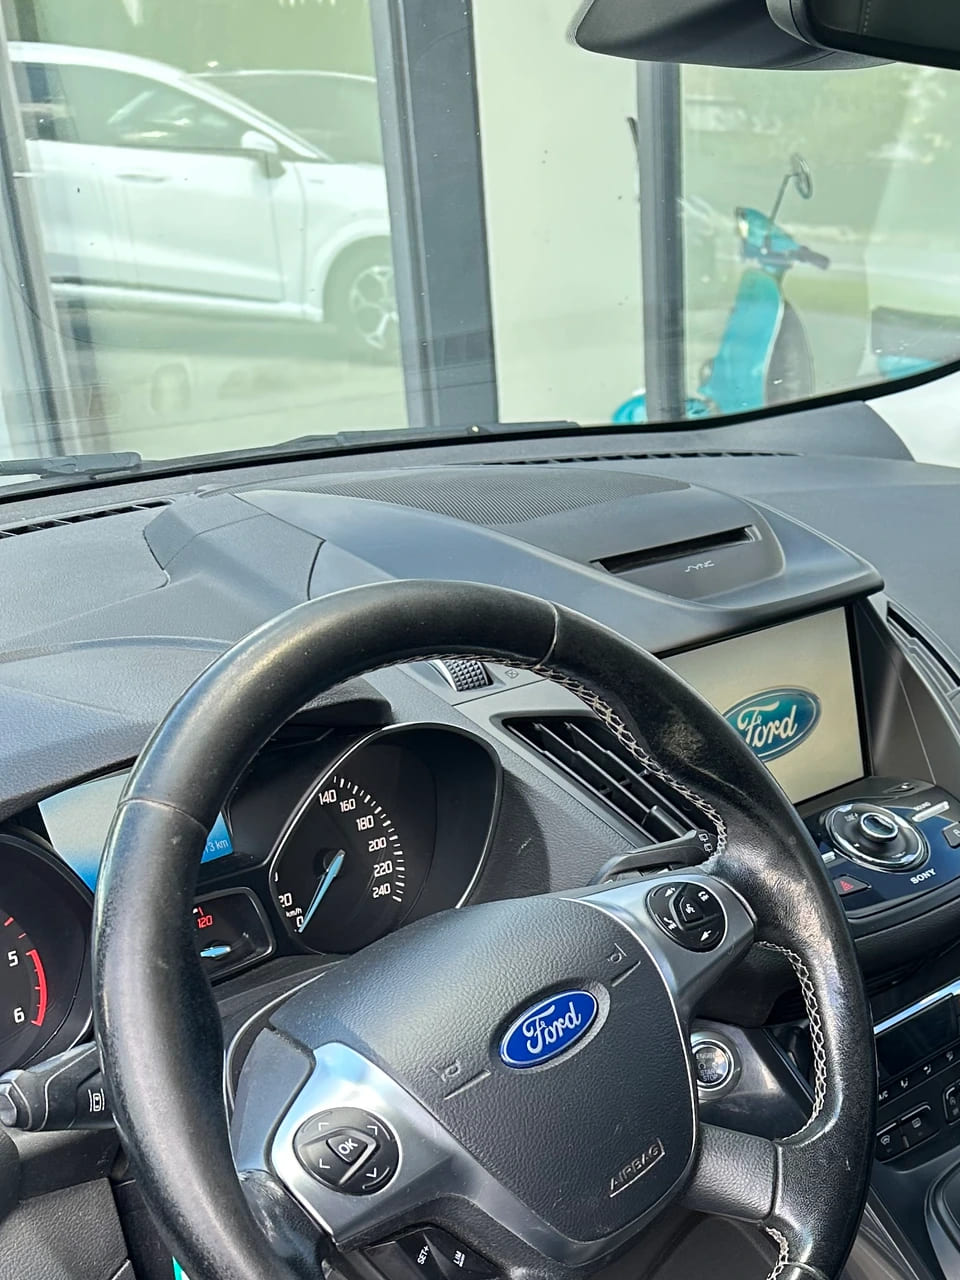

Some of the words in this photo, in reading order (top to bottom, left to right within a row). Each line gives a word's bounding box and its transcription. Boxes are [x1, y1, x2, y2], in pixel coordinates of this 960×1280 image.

[737, 700, 798, 748] Ford
[318, 789, 337, 805] 140
[339, 798, 356, 812] 160
[356, 815, 374, 831] 180
[368, 837, 387, 852] 200
[373, 860, 393, 878] 220
[910, 868, 937, 885] SONY
[372, 883, 391, 898] 240
[197, 915, 213, 928] 120
[296, 915, 304, 928] 0
[7, 950, 19, 967] 5
[13, 1007, 25, 1024] 6
[522, 1001, 582, 1054] Ford
[702, 1073, 719, 1082] STOP
[338, 1138, 358, 1155] OK
[610, 1144, 659, 1191] AIRBAG
[416, 1245, 430, 1265] SET+
